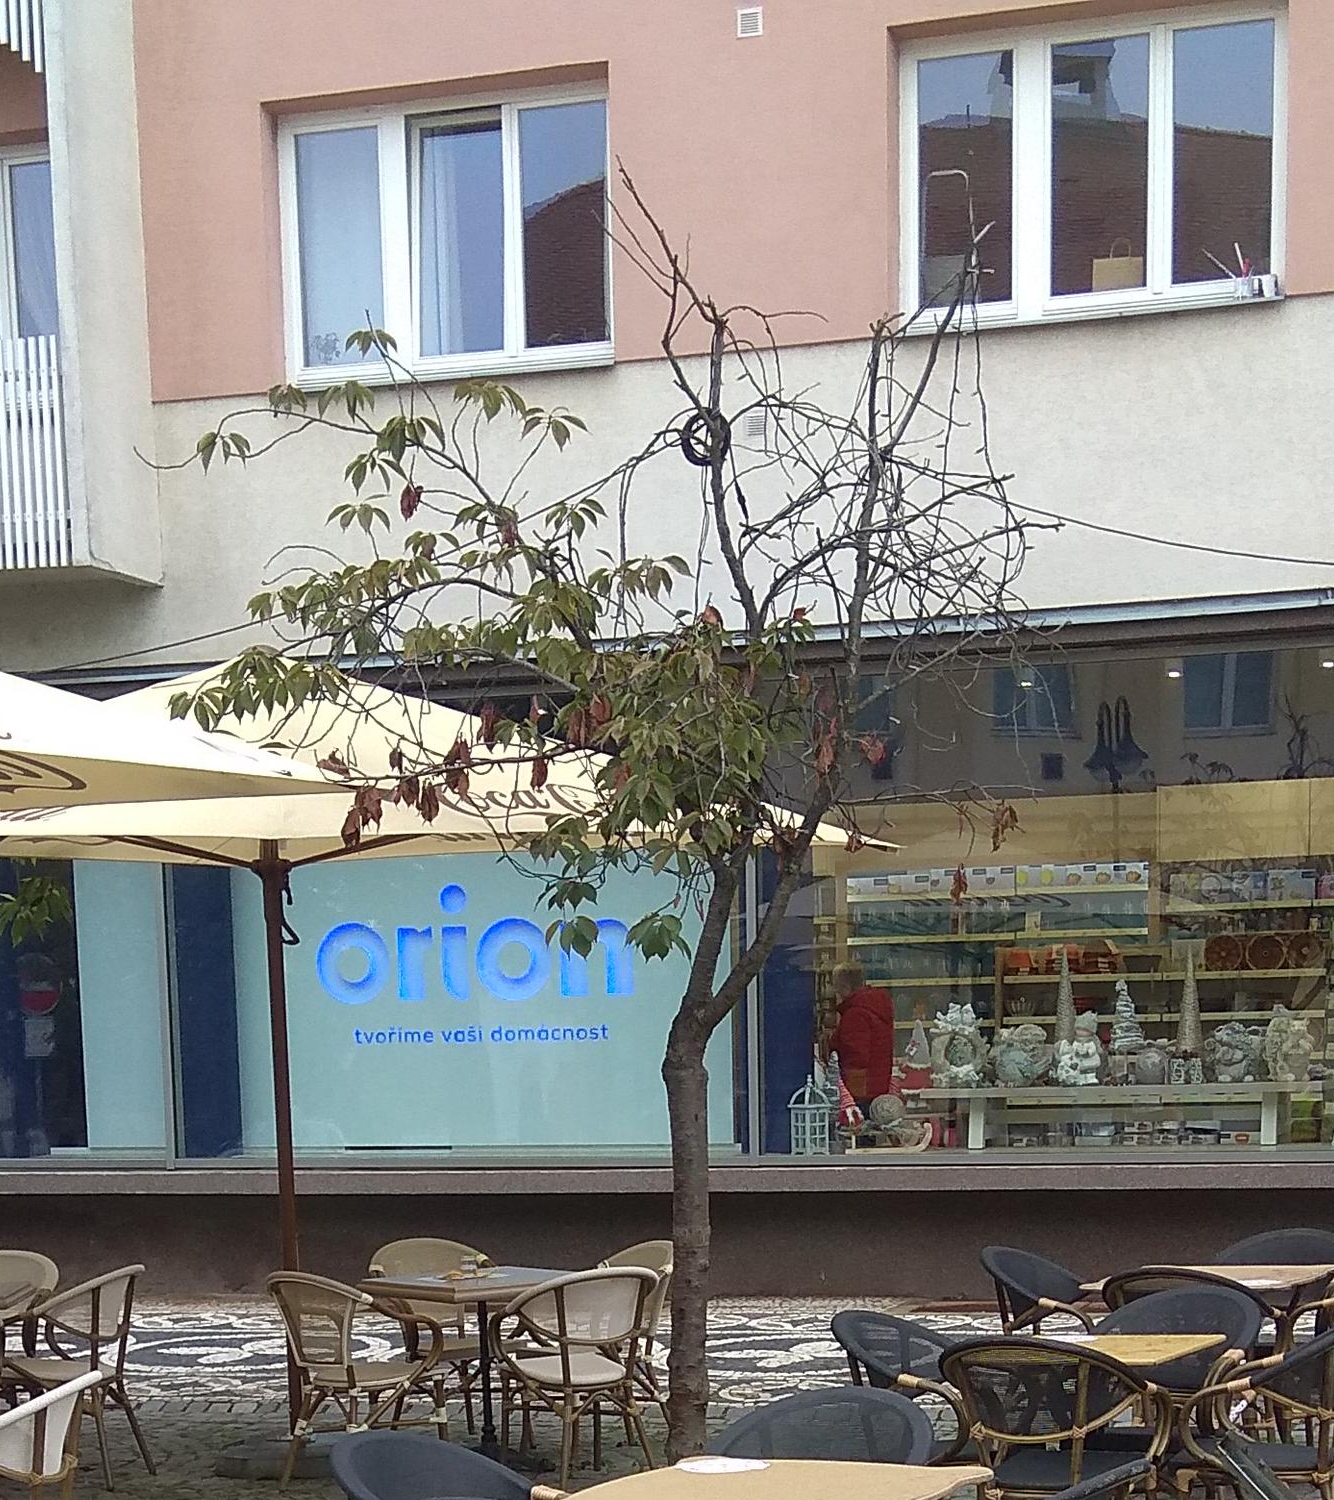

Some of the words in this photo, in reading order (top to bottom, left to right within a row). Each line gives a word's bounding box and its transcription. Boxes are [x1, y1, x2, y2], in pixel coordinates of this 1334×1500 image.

[315, 882, 636, 1005] orion
[440, 1025, 483, 1043] vaši
[489, 1024, 609, 1043] domácnost
